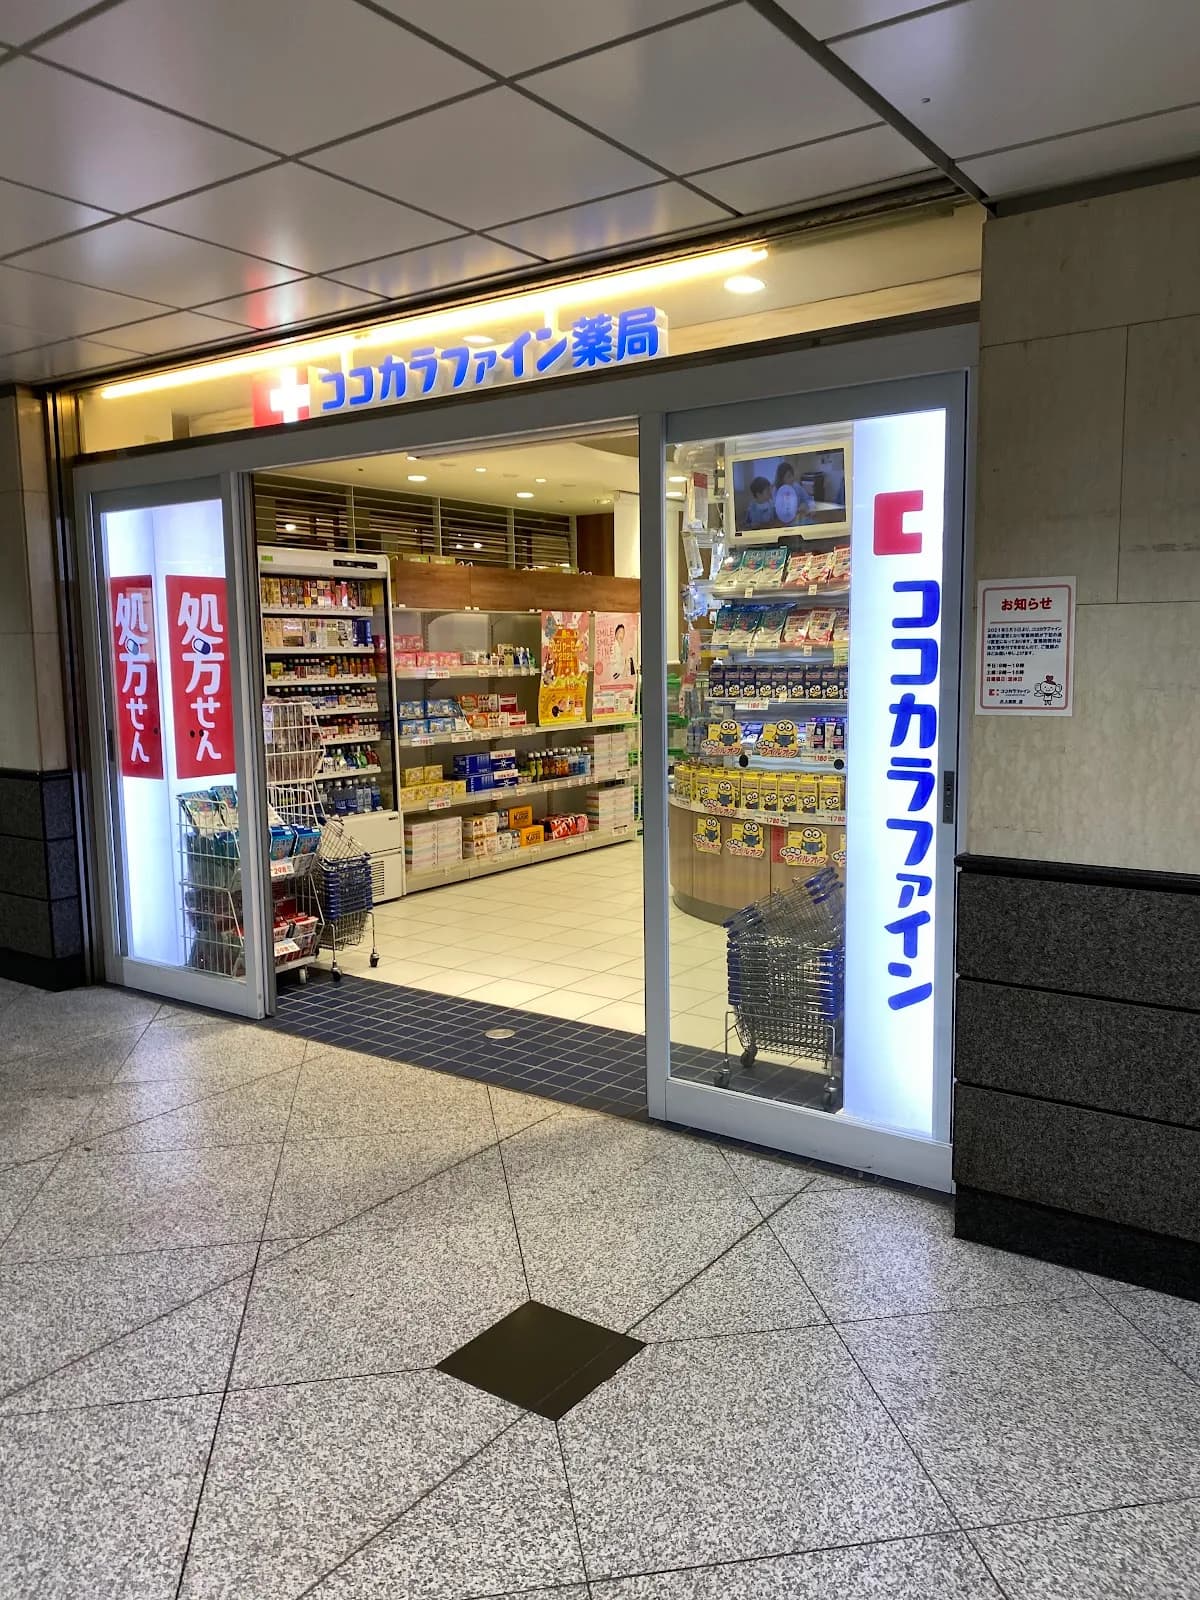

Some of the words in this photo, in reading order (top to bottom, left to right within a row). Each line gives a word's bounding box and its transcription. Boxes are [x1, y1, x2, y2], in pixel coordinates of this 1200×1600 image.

[321, 305, 660, 411] ココカラファイン薬局
[115, 592, 150, 763] 処方せん
[178, 592, 224, 762] 処方せん
[1001, 597, 1053, 611] お知らせ
[884, 579, 940, 1011] ココカラファイン
